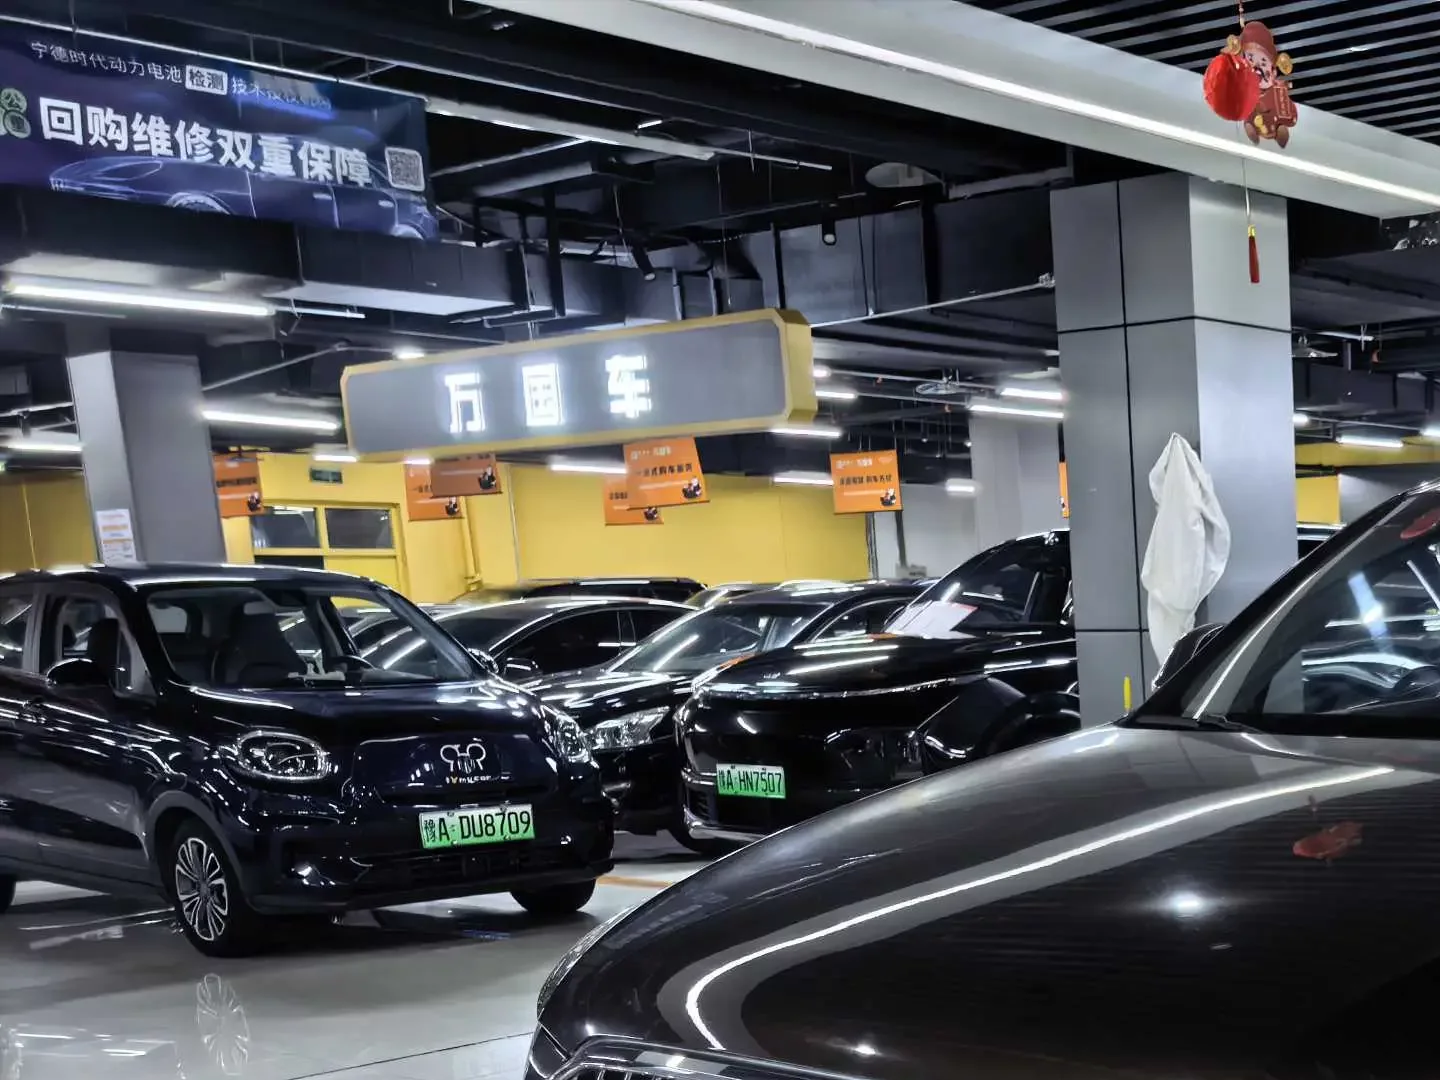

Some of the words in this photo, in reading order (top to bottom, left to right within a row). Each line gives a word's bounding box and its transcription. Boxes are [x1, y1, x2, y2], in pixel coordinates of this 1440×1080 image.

[39, 97, 373, 187] 回购维修双重保障
